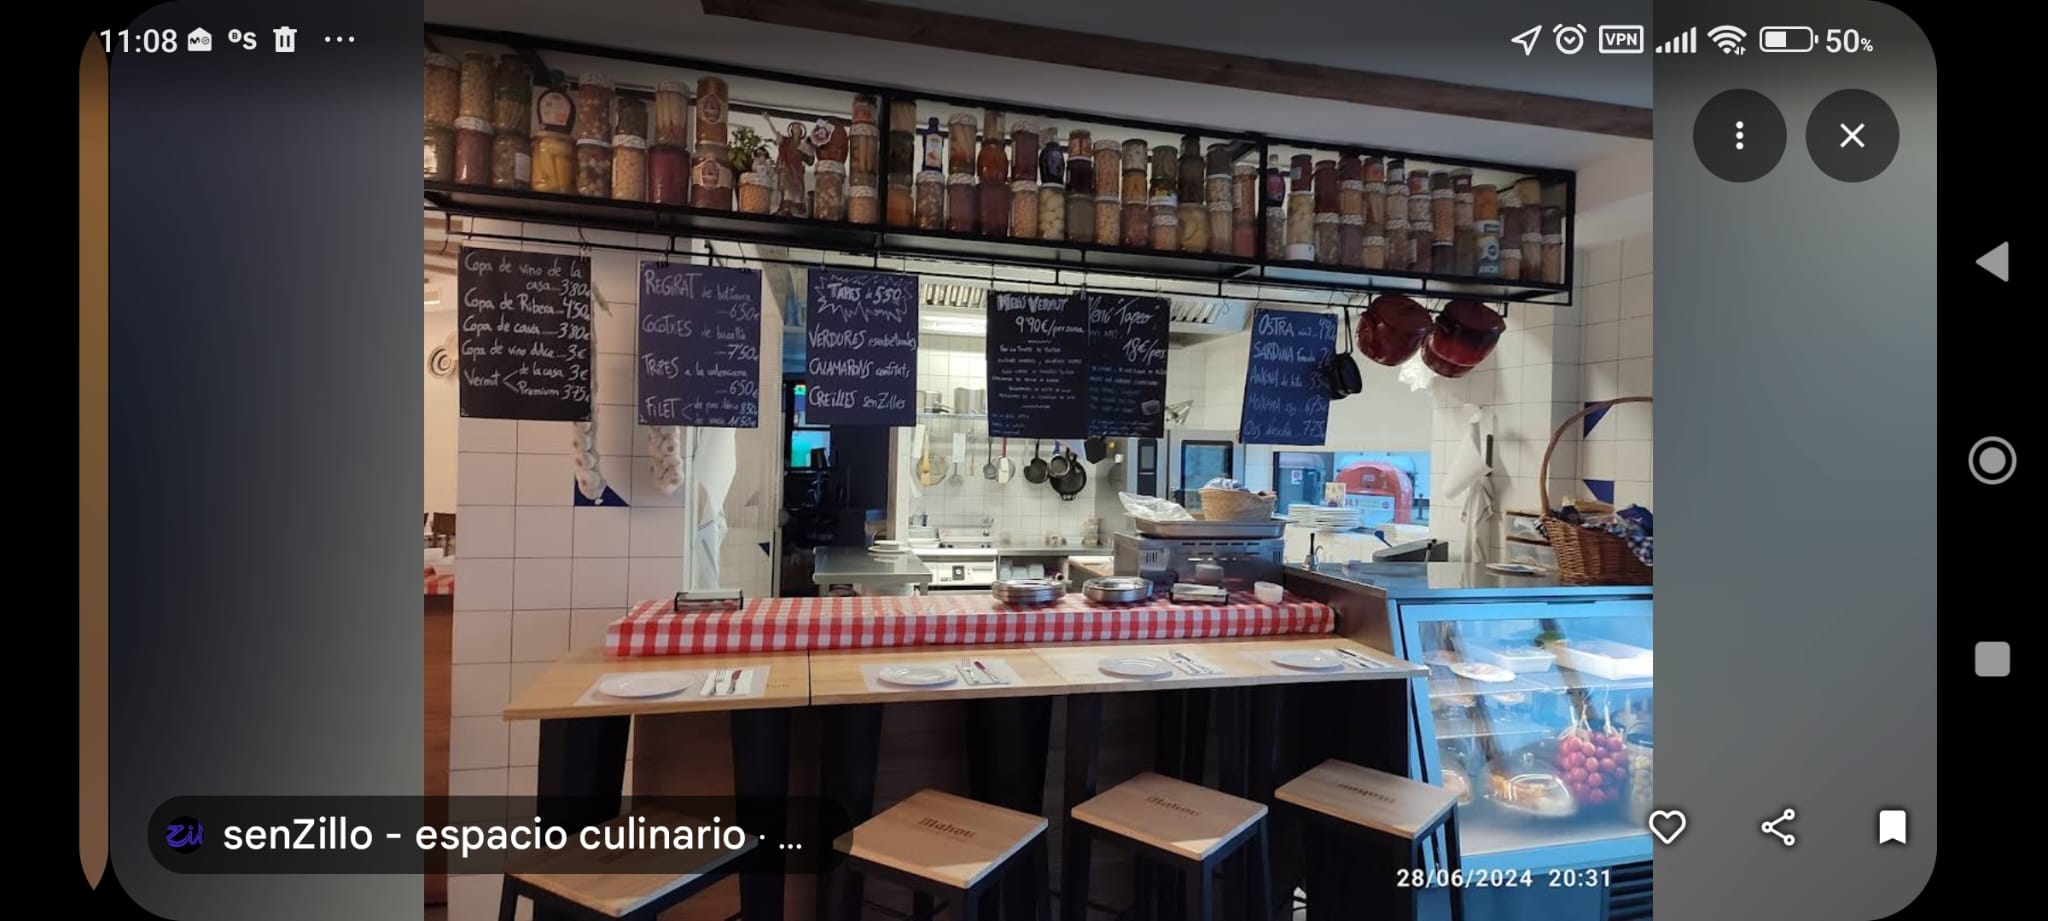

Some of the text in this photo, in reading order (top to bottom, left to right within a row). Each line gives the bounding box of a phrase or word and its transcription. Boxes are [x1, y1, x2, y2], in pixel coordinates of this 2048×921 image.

[464, 252, 493, 276] Copa
[498, 255, 512, 273] de
[519, 264, 542, 276] vino
[547, 257, 562, 276] de
[526, 280, 551, 292] casa
[464, 287, 495, 312] Copa
[499, 291, 515, 310] de
[517, 293, 554, 314] Ribera
[463, 314, 493, 338] Copa
[497, 313, 511, 332] de
[514, 323, 541, 335] cava
[1258, 313, 1295, 337] OSTRA
[461, 337, 588, 362] Copa de vino dulce 3€
[519, 361, 589, 381] de la casa 3€
[517, 380, 560, 396] Premium
[918, 816, 977, 840] Mahou
